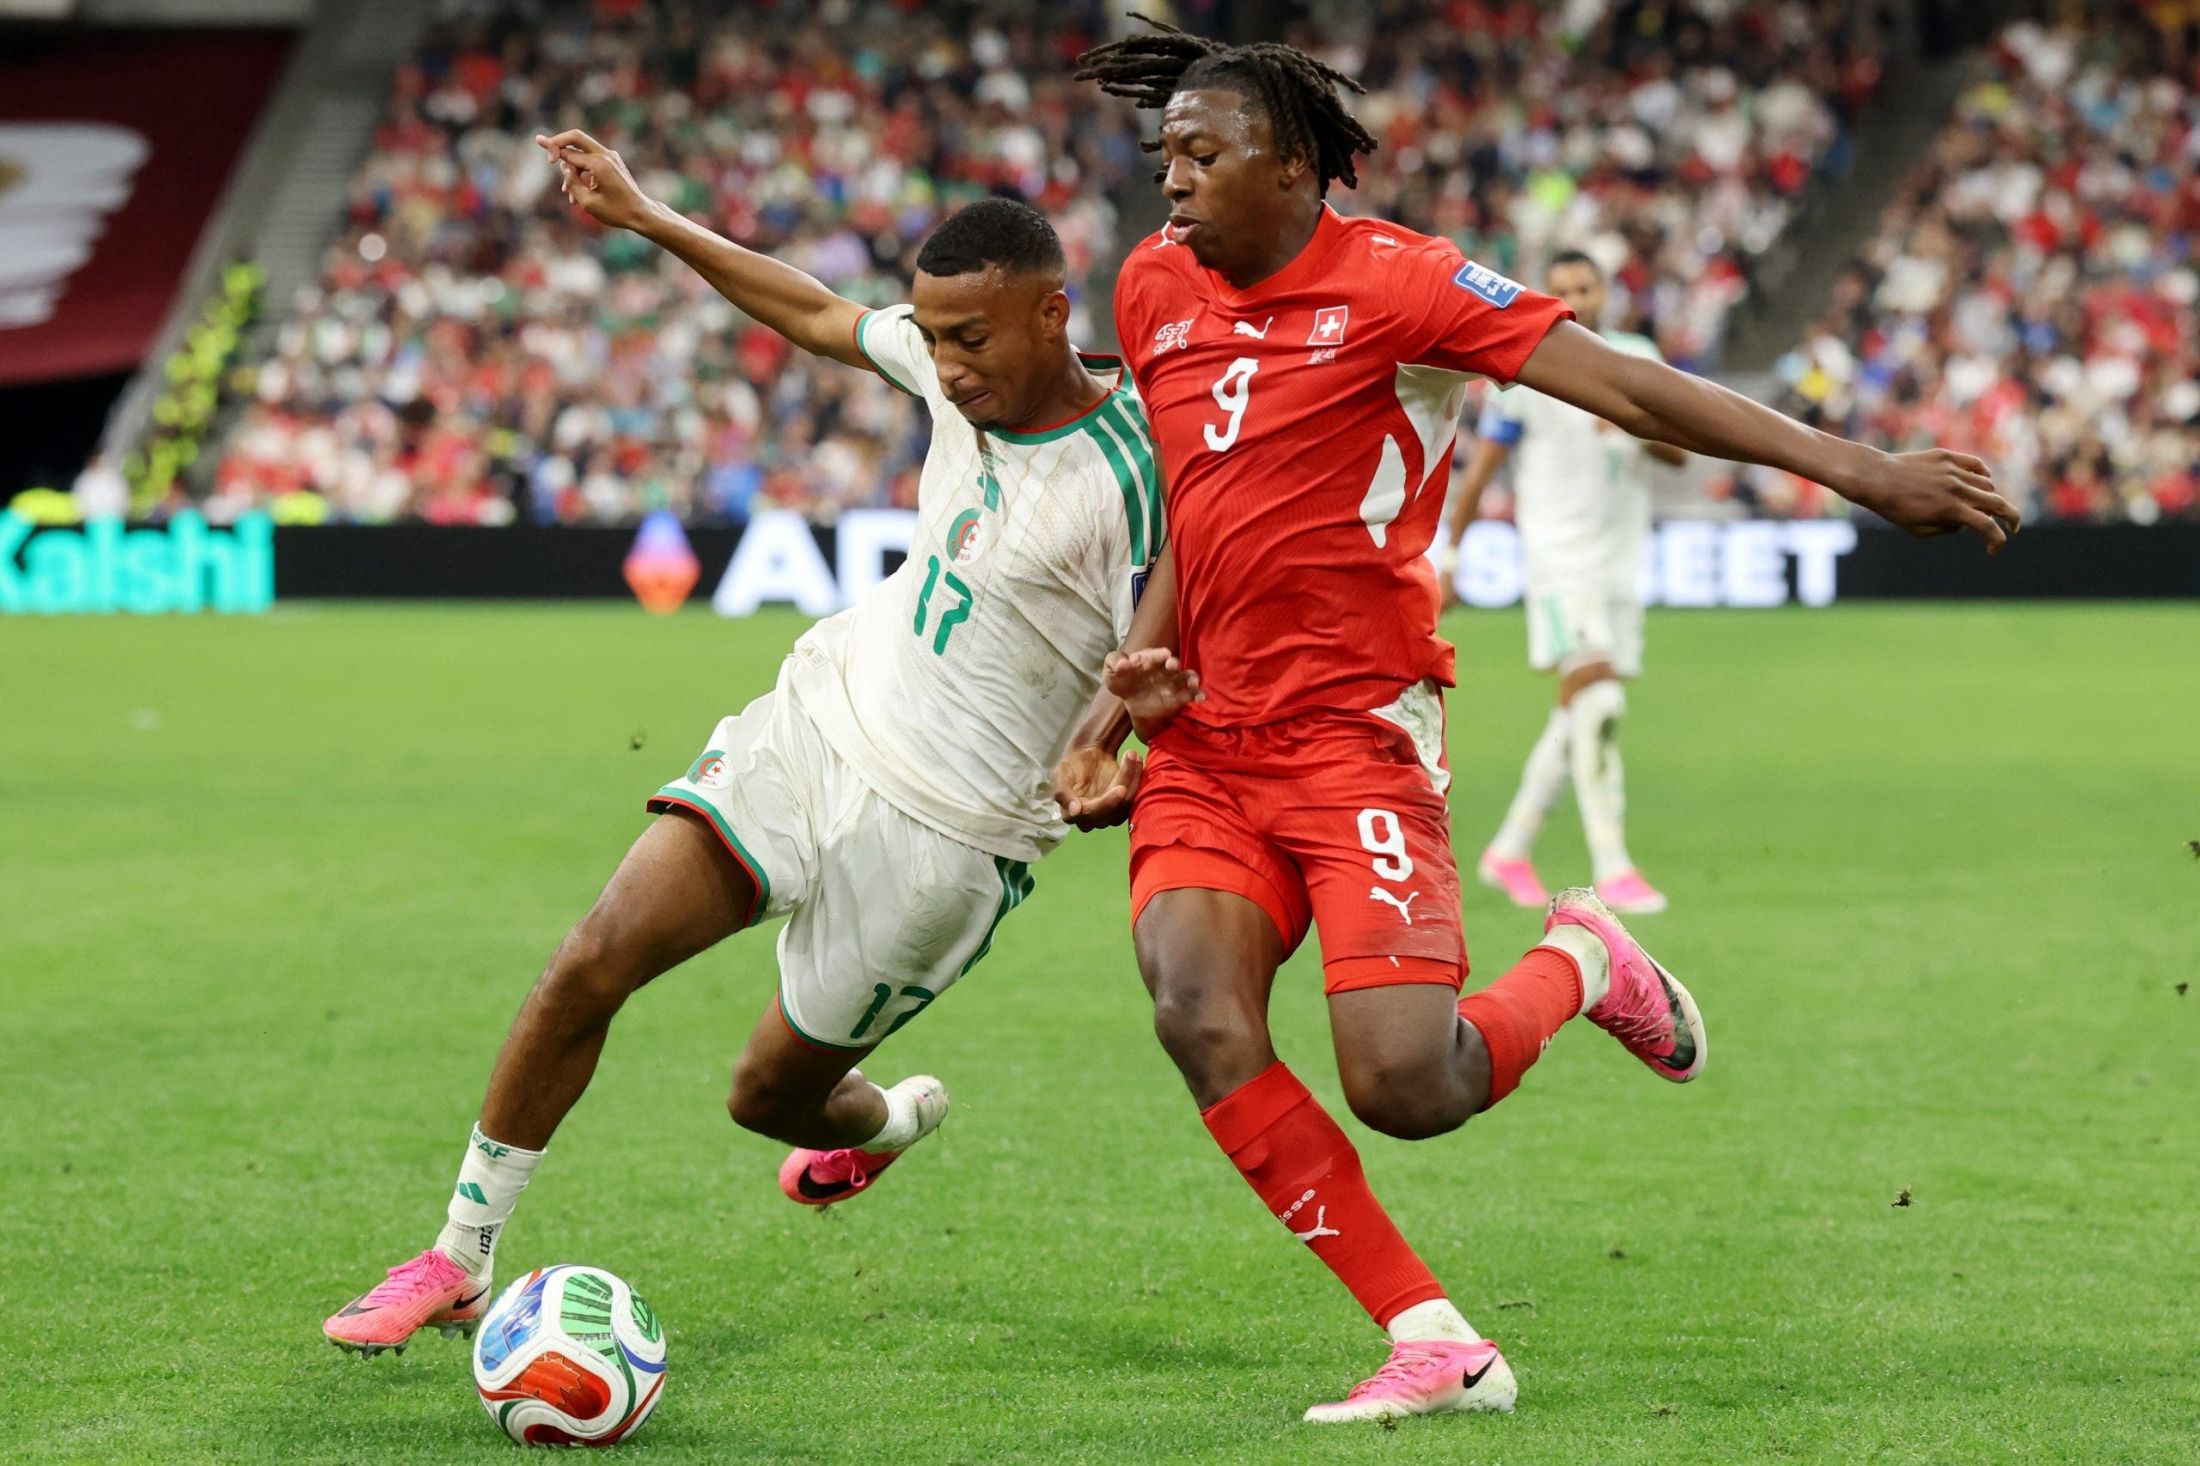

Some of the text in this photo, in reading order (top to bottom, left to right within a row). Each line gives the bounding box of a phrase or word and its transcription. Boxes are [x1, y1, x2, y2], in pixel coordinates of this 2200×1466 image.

[1203, 357, 1260, 452] 9
[914, 554, 974, 656] 17
[1356, 808, 1414, 882] 9
[850, 982, 936, 1039] 17
